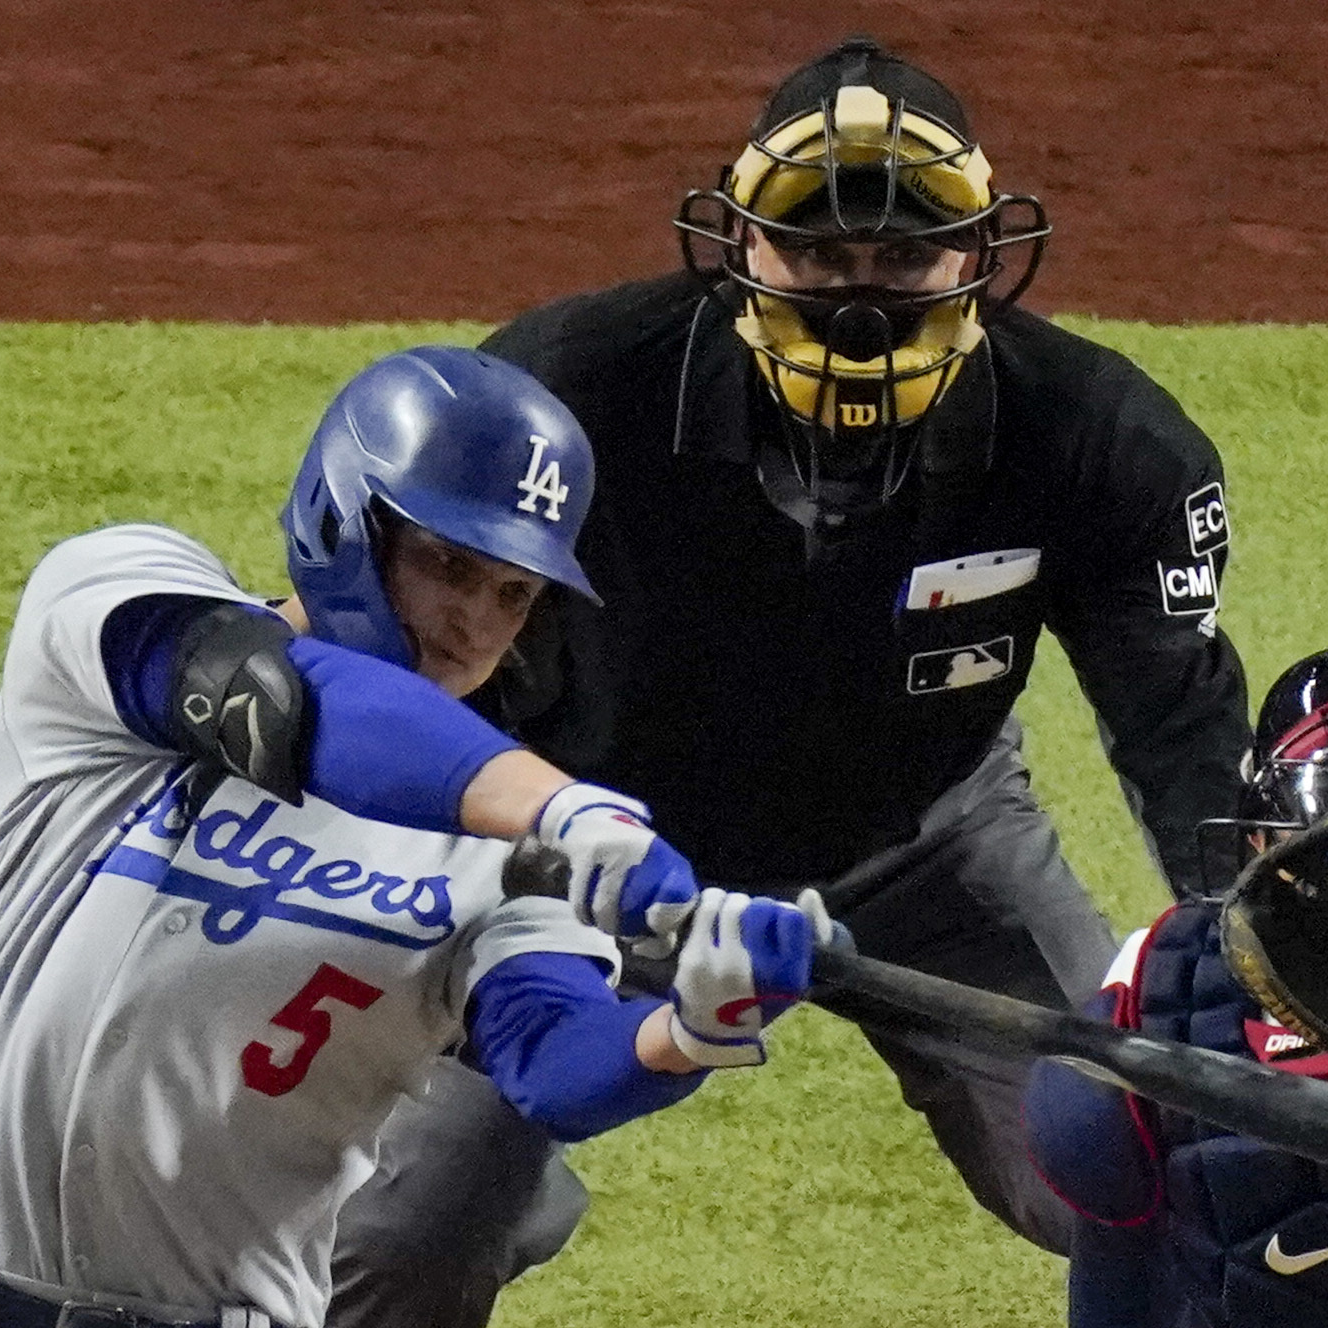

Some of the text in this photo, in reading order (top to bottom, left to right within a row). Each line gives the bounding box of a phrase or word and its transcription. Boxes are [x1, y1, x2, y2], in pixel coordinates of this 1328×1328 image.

[517, 434, 569, 522] LA
[1190, 500, 1224, 542] EC
[1165, 565, 1214, 598] CM
[240, 962, 385, 1097] 5
